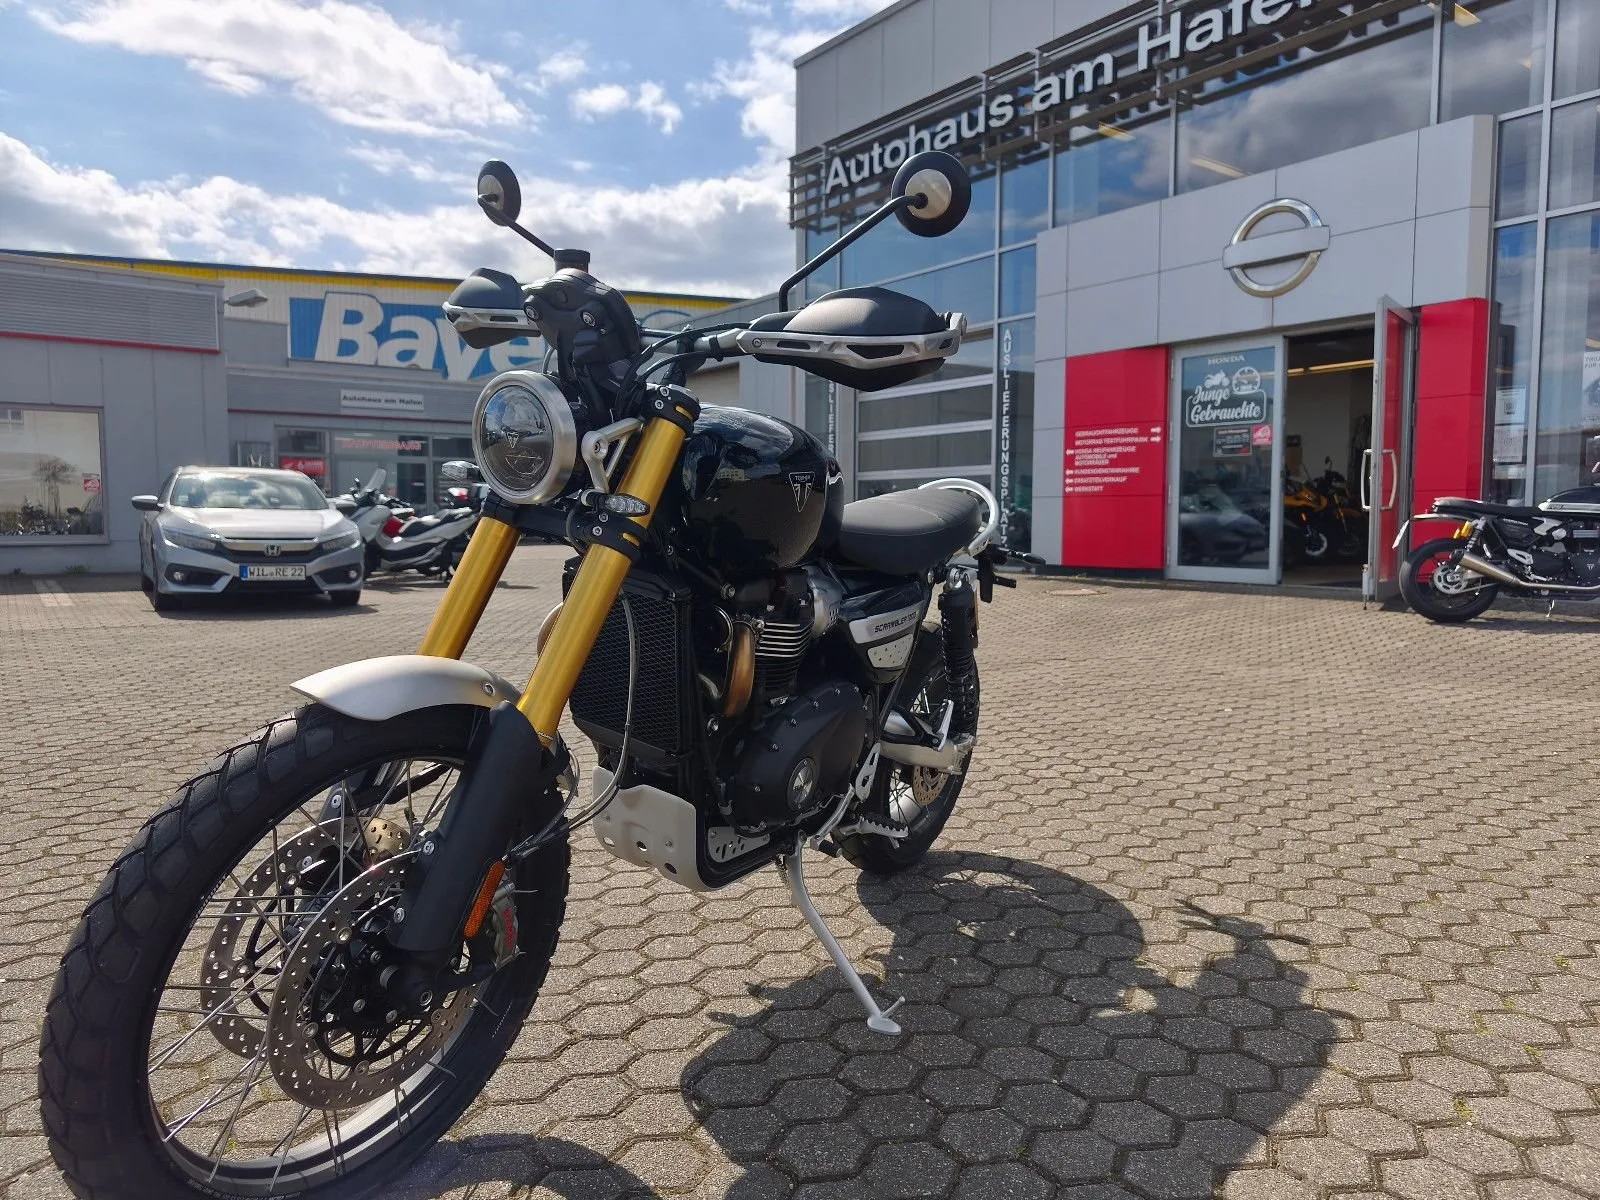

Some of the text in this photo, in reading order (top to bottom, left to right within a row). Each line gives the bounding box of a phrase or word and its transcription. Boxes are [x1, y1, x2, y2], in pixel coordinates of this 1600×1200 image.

[825, 0, 1313, 194] Autohaus am Hafe
[1207, 355, 1246, 365] HONDA
[342, 395, 382, 403] Autohaus
[1191, 385, 1231, 406] Junge
[1190, 401, 1262, 424] Gebrauchte
